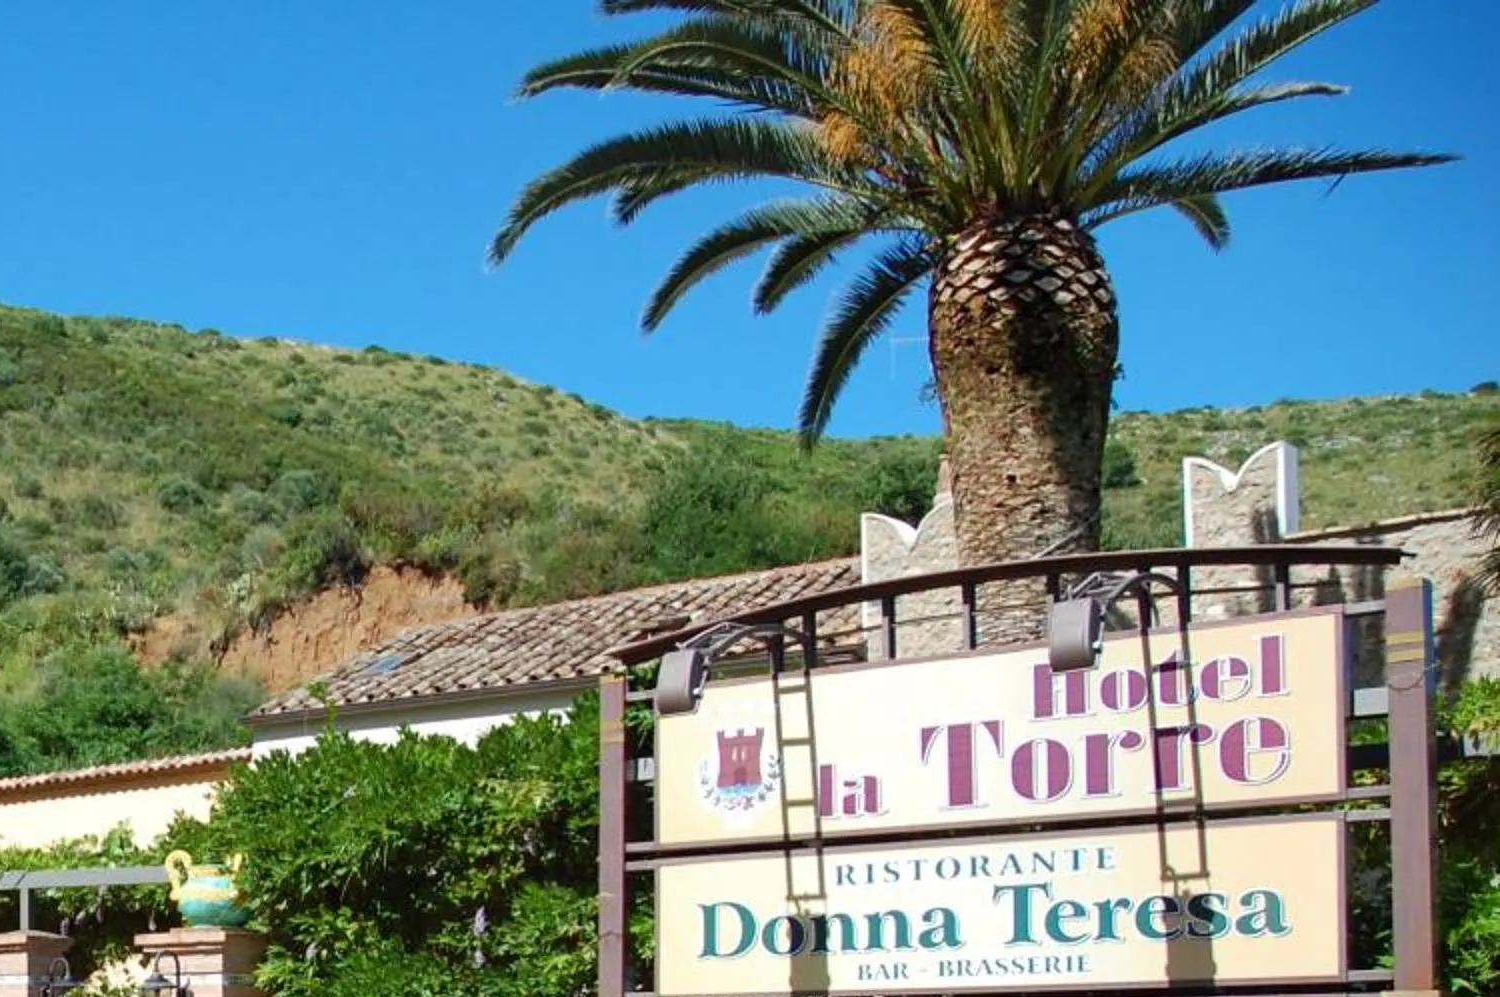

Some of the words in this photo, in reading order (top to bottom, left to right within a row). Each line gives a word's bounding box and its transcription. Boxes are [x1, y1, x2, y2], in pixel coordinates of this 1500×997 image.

[819, 764, 890, 819] la
[920, 715, 1291, 811] Torre
[835, 847, 1116, 886] RISTORANTE
[696, 900, 967, 962] Donna
[992, 881, 1293, 948] Teresa
[857, 962, 909, 982] BAR
[938, 955, 1092, 978] BRASSERIE
